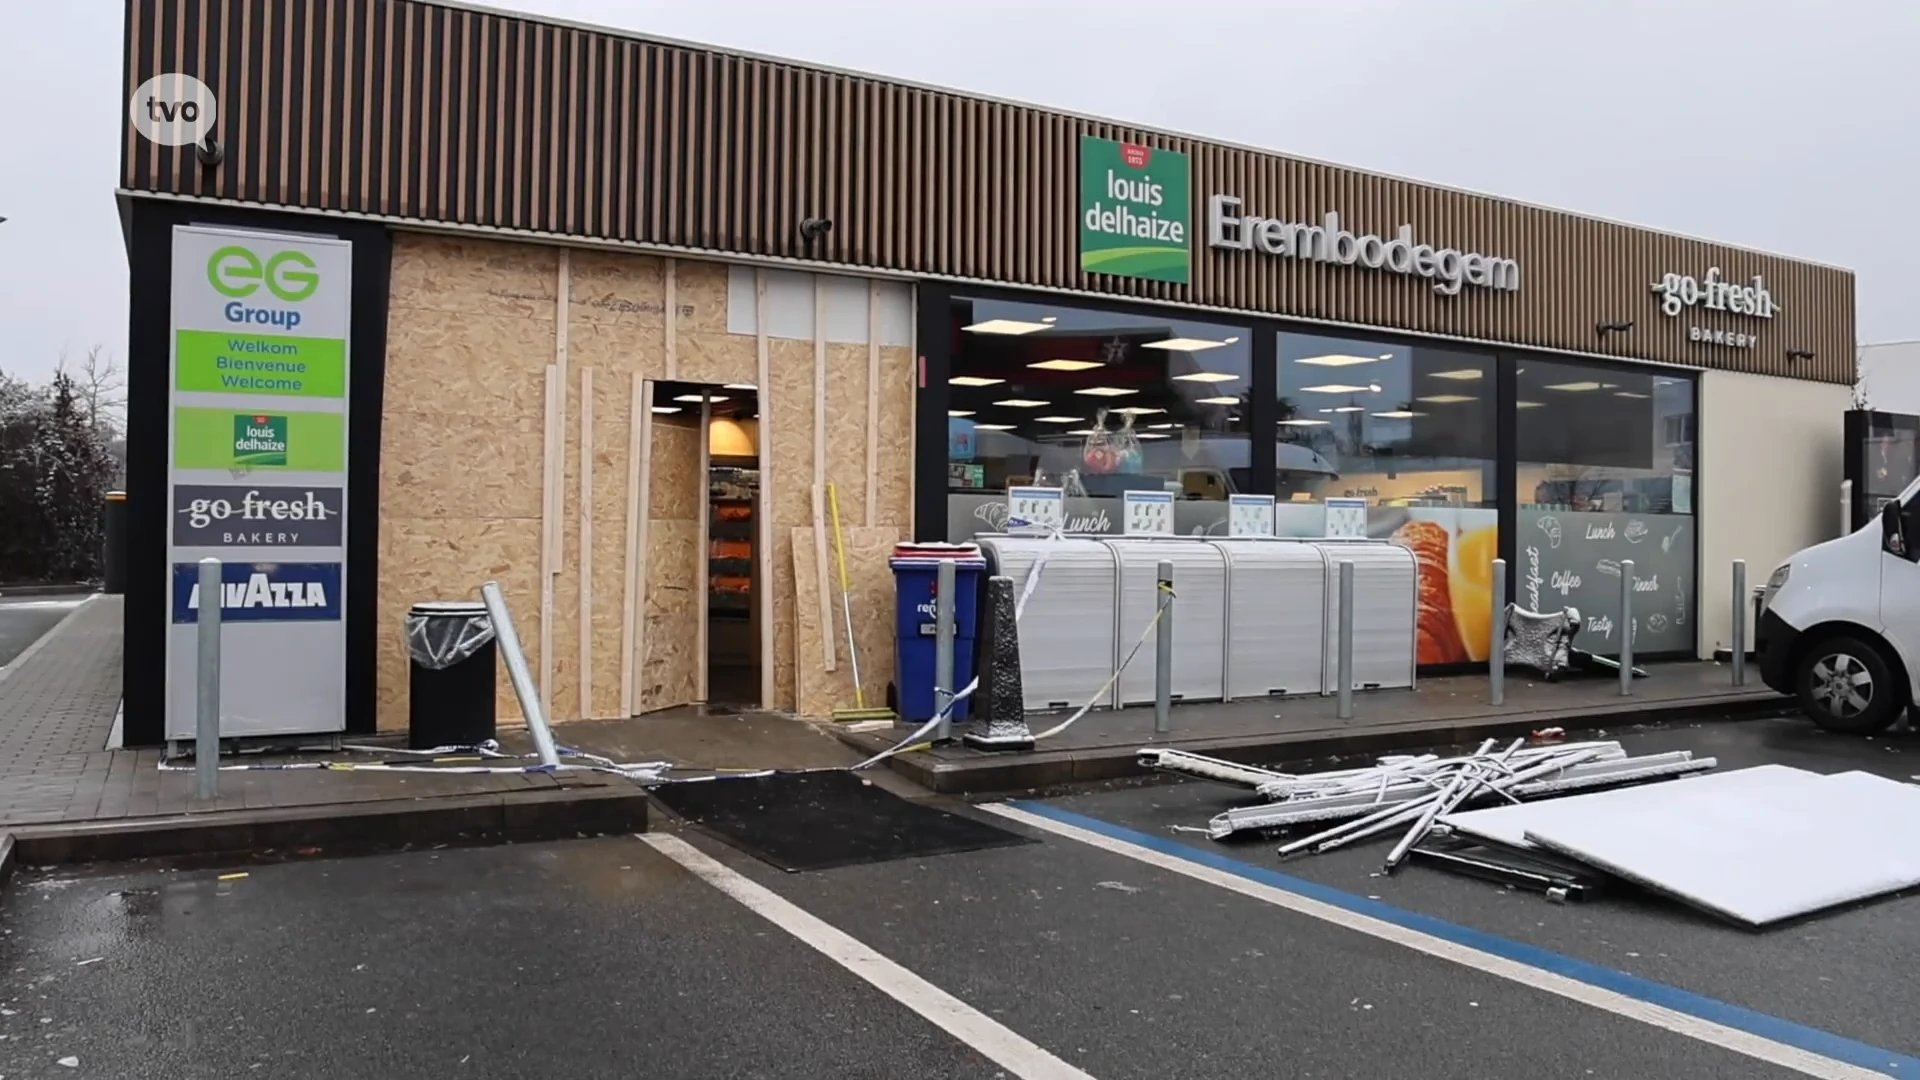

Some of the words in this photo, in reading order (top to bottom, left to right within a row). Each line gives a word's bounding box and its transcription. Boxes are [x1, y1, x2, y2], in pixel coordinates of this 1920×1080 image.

[1107, 169, 1163, 206] louis
[1085, 201, 1184, 243] delhaize
[1209, 193, 1519, 296] Erembodegem
[1662, 272, 1698, 316] go
[1704, 266, 1773, 318] fresh
[225, 302, 300, 329] Group
[228, 339, 298, 355] Welkom
[1689, 326, 1757, 348] BAKERY
[216, 356, 306, 373] Bienvenue
[221, 374, 303, 390] Welcome
[247, 425, 275, 438] louis
[236, 437, 285, 451] delhaize
[189, 499, 231, 528] go
[241, 490, 327, 520] fresh
[1062, 509, 1111, 532] Lunch
[223, 533, 299, 543] BAKERY
[1585, 521, 1616, 540] Lunch
[1551, 570, 1581, 596] Coffee
[1587, 615, 1613, 640] Tasty
